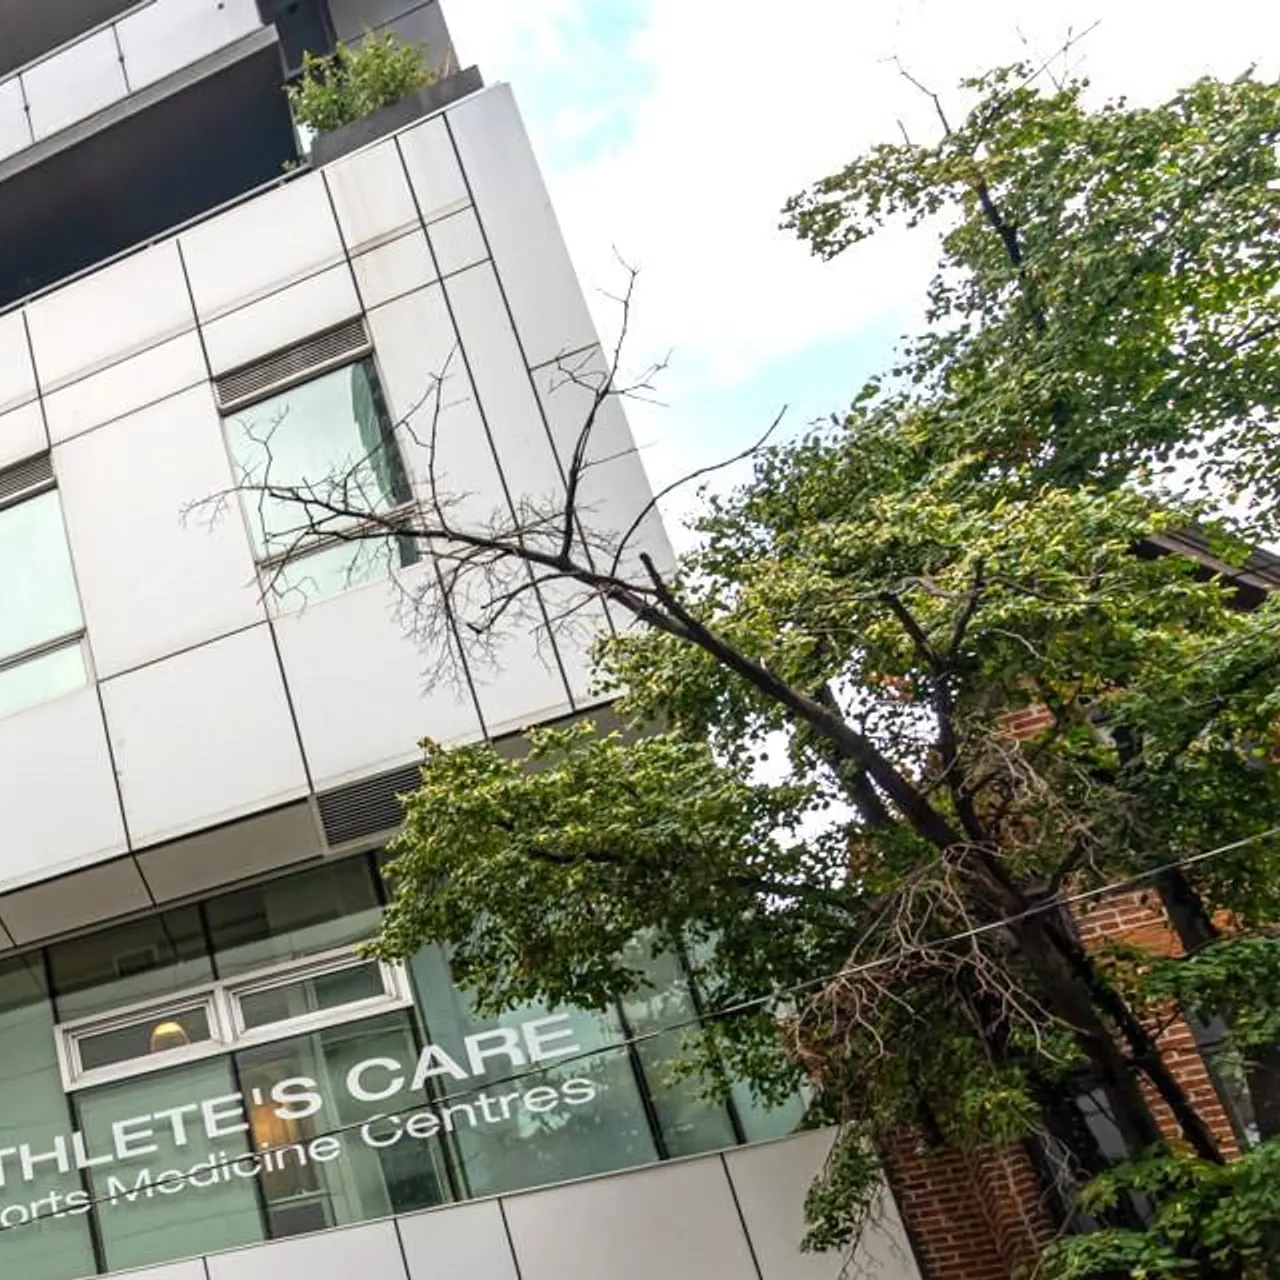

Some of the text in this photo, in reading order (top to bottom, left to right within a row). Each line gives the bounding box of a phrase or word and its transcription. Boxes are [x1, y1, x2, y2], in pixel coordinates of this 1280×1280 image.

[346, 1012, 581, 1102] CARE
[107, 1136, 341, 1206] Medicine
[360, 1077, 596, 1147] Centres
